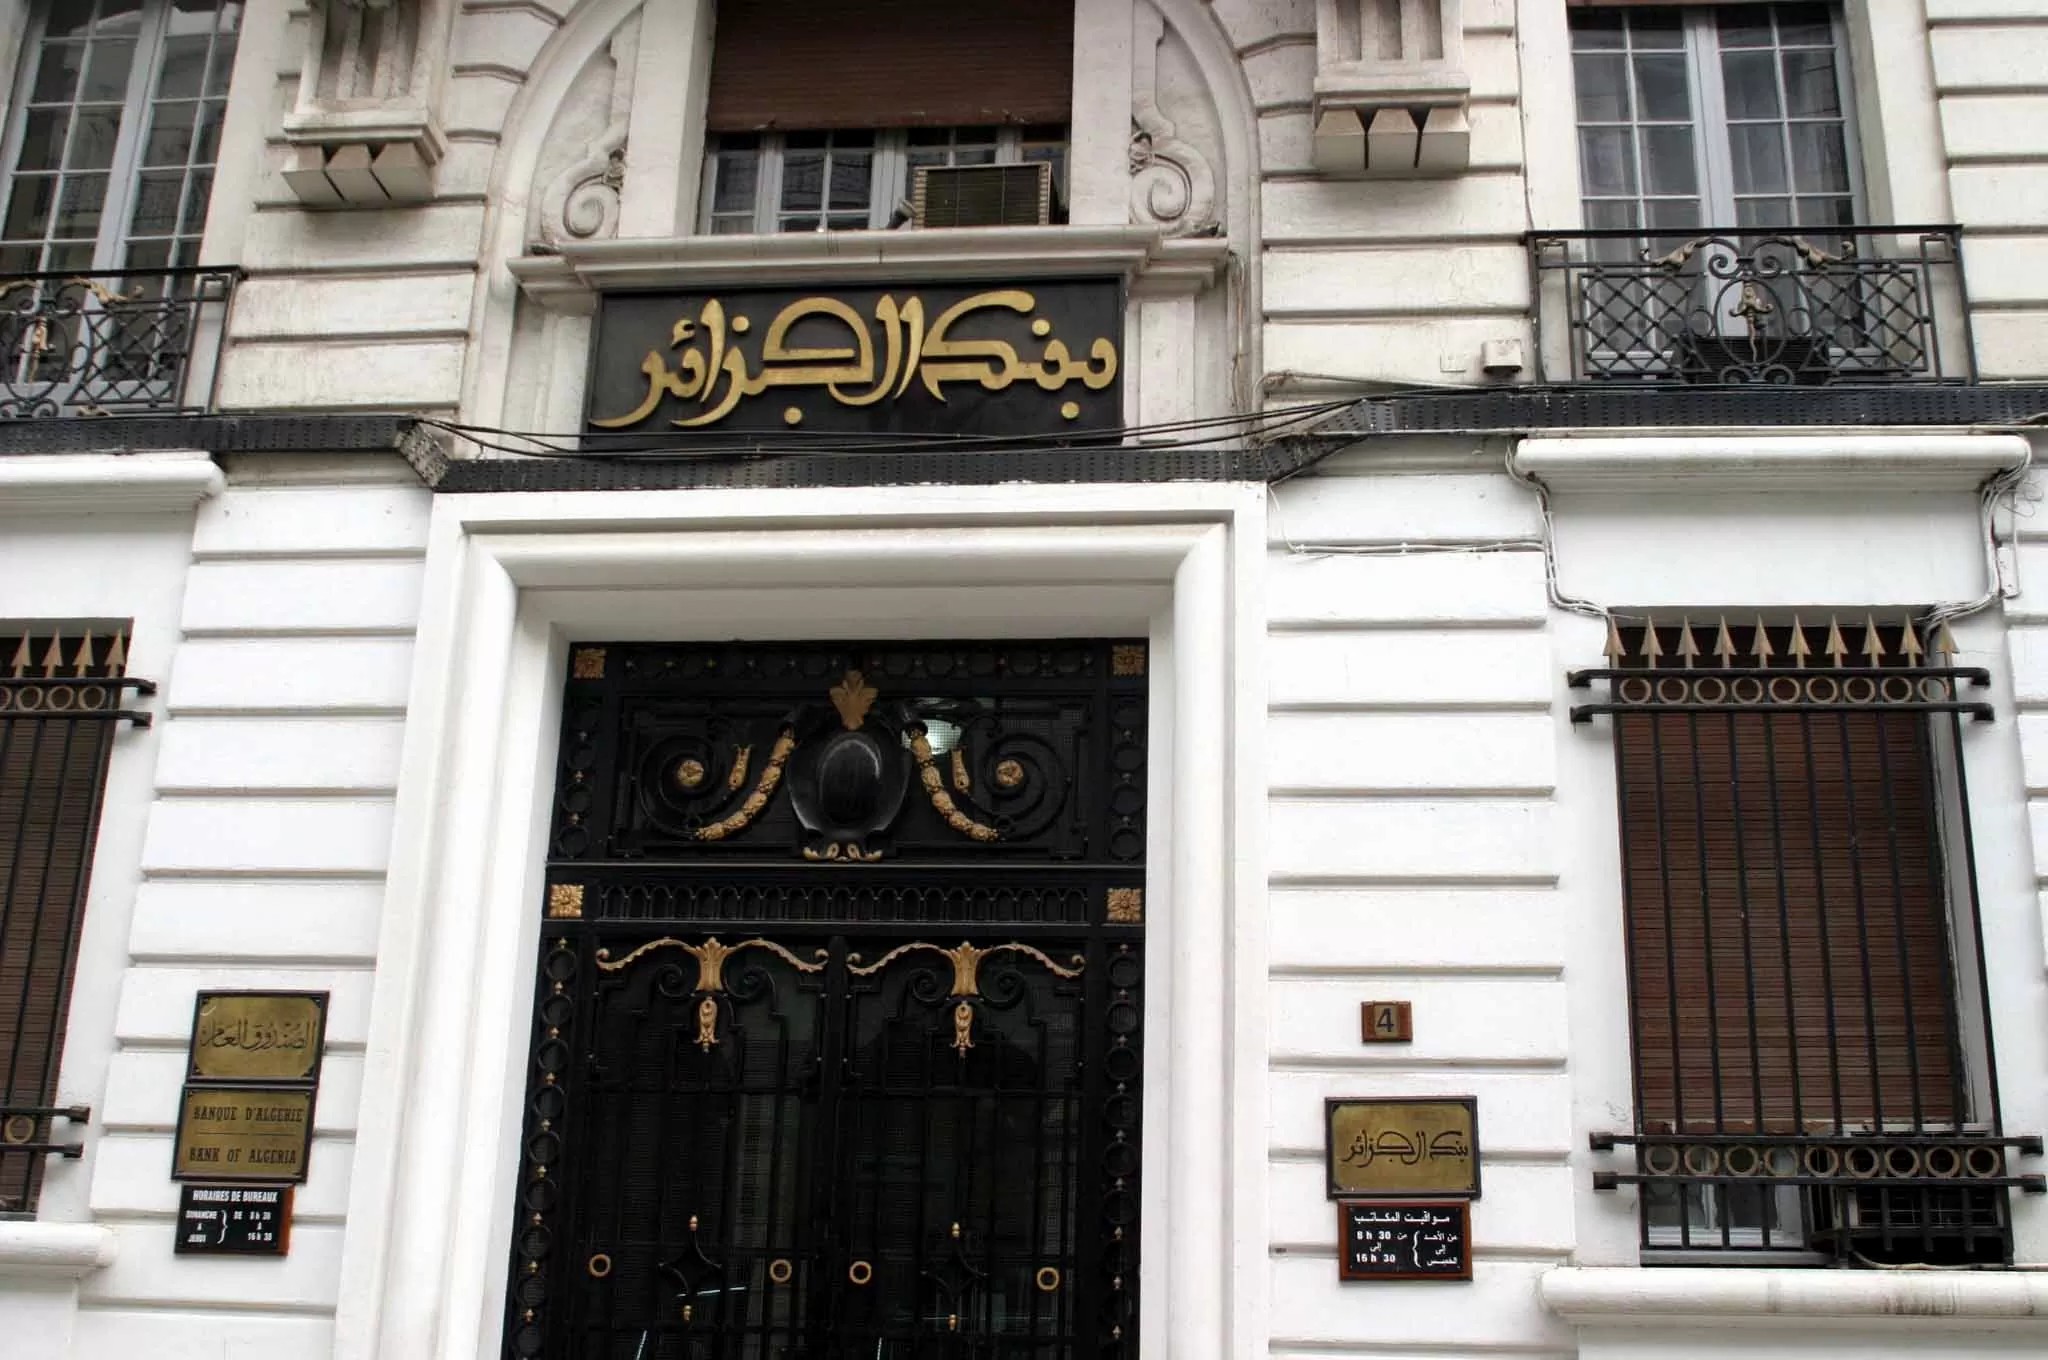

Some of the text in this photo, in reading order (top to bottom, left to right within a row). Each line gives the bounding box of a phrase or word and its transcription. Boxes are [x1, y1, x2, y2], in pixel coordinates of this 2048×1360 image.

[589, 290, 1118, 428] بنك الجزائر
[1376, 1008, 1395, 1032] 4
[192, 1106, 304, 1122] BANQUE D'ALGERIE
[189, 1147, 296, 1164] BANK OF ALGERIA
[1341, 1129, 1468, 1168] بنك الجزائر
[193, 1190, 278, 1203] HORAIRES DE BUREAUX
[185, 1210, 218, 1220] DIMANCHE
[1366, 1230, 1372, 1240] h
[1378, 1230, 1391, 1240] 30
[1356, 1253, 1396, 1263] 16 h 30
